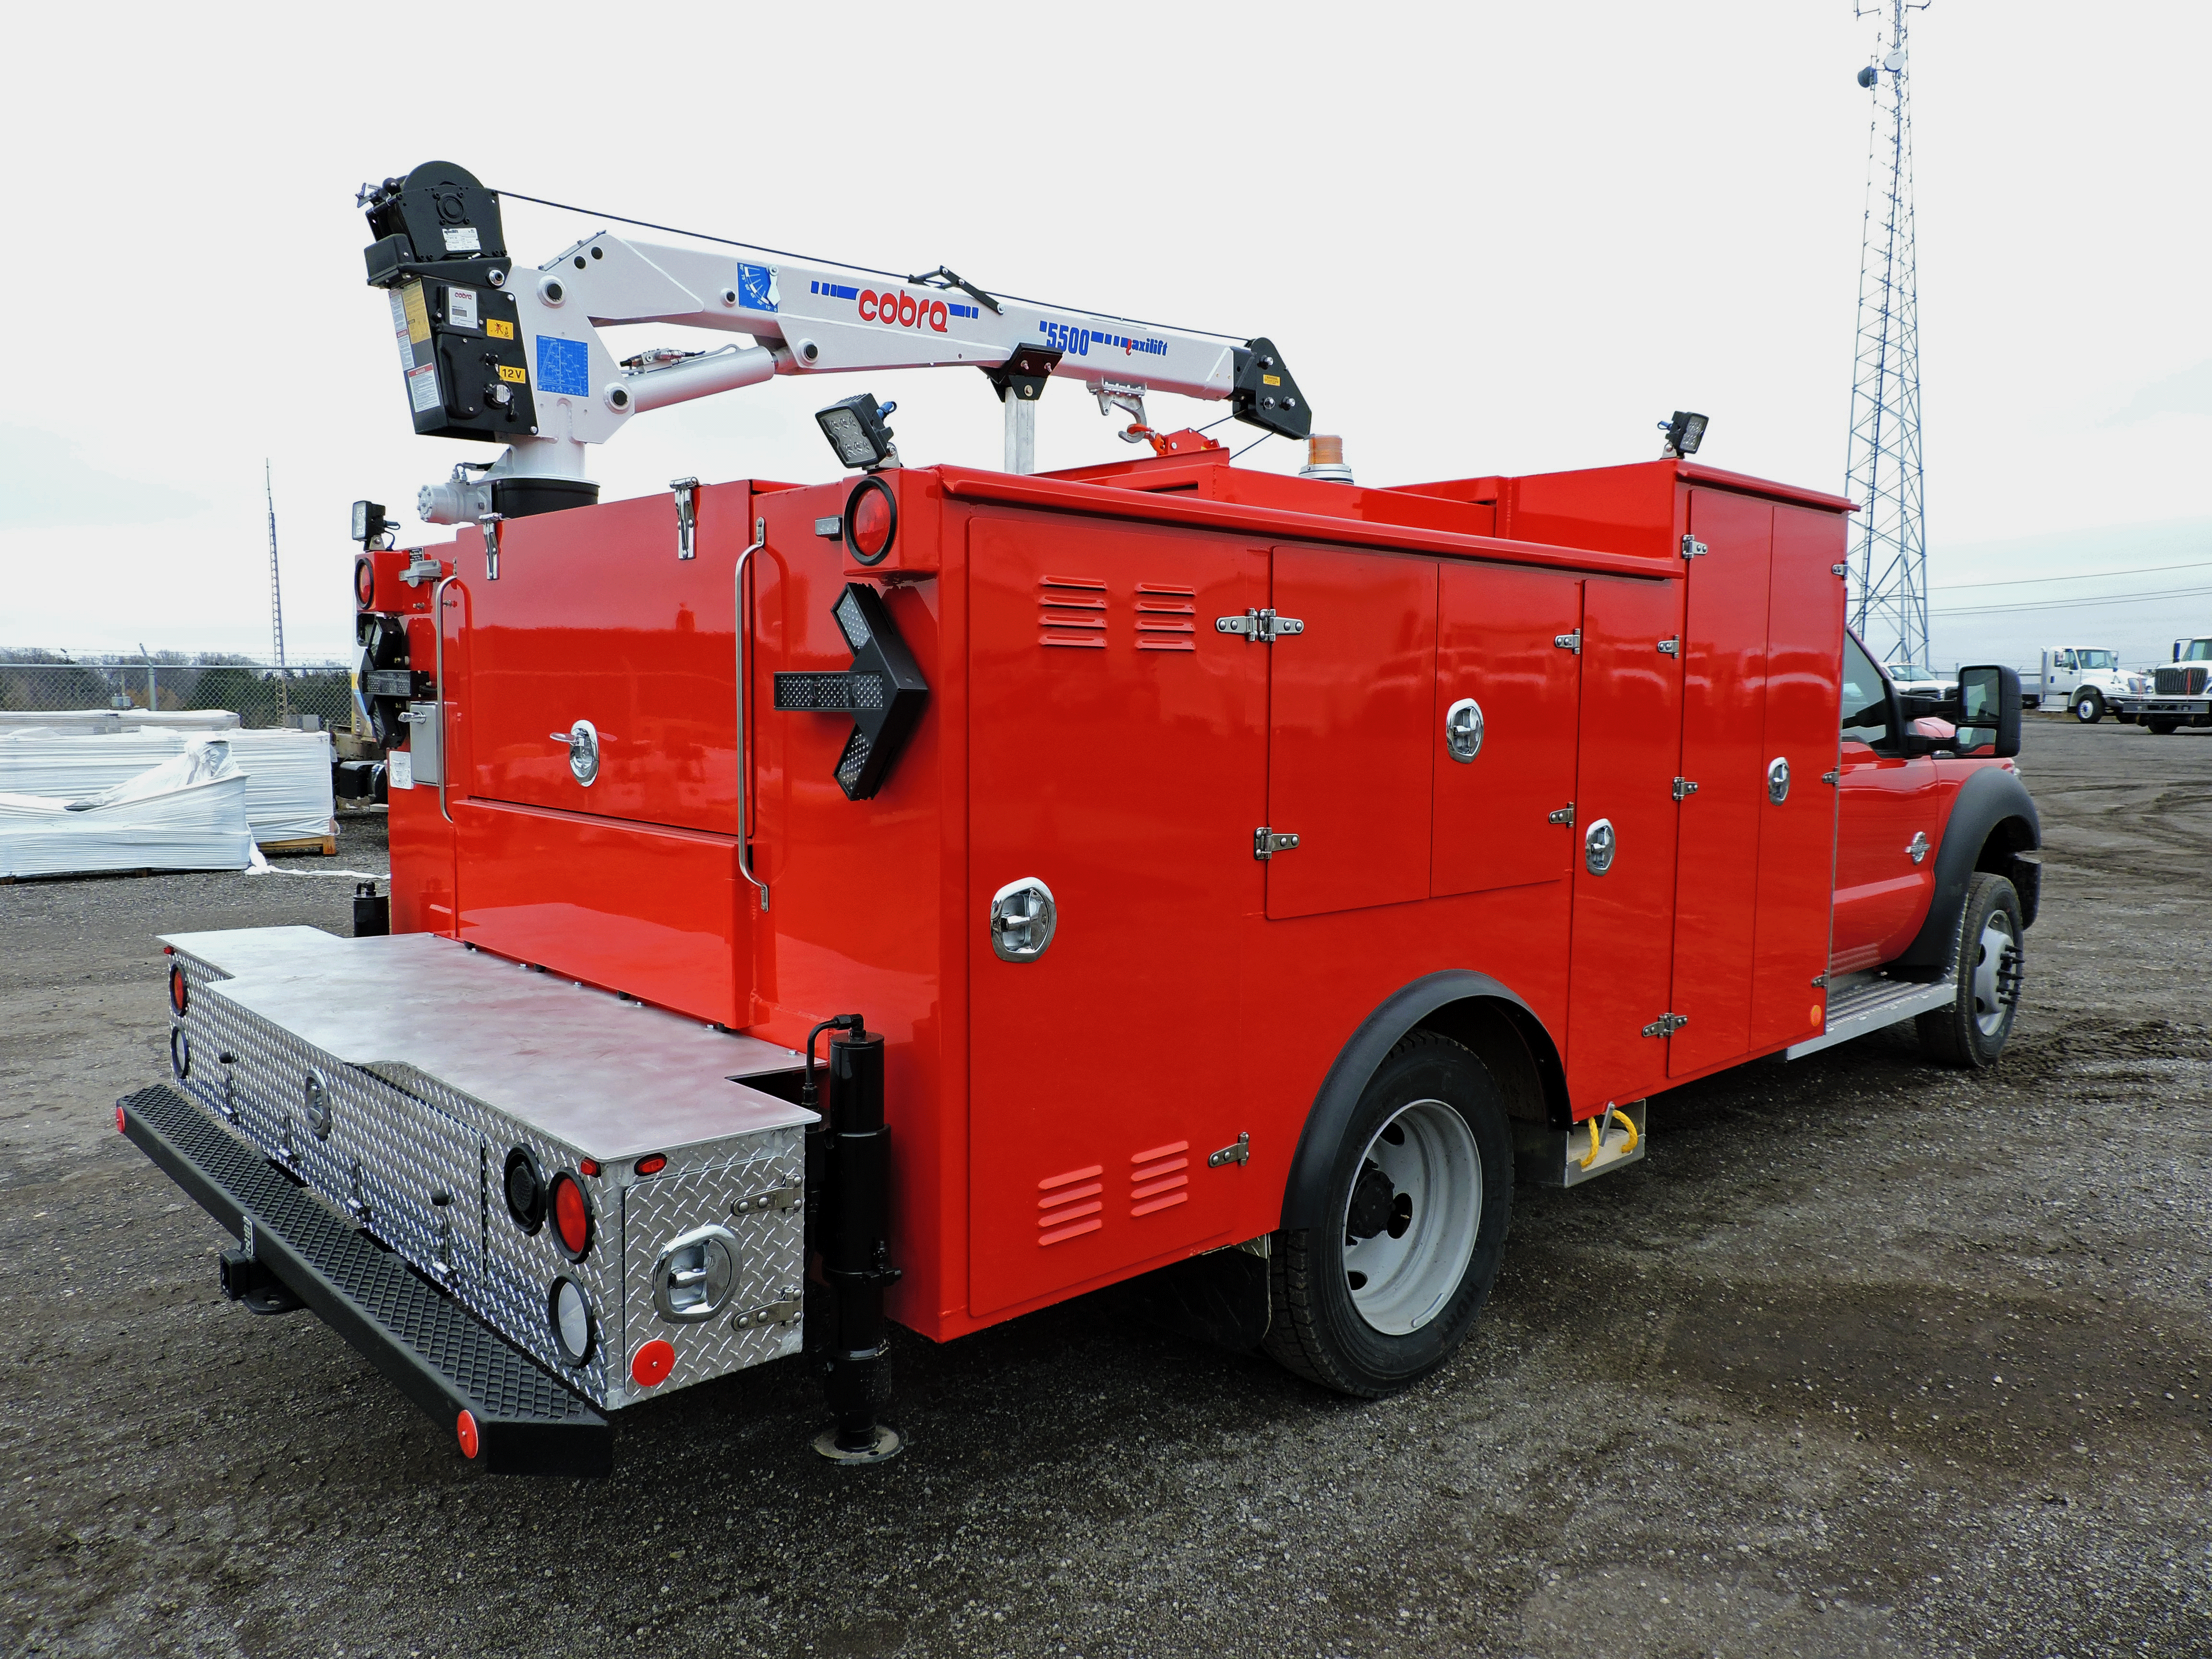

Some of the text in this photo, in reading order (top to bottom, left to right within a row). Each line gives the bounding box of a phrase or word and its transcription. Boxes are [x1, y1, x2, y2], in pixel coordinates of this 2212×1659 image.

[455, 292, 472, 300] cobra
[858, 289, 948, 333] cobra
[1046, 322, 1090, 356] 5500
[502, 369, 521, 379] 12V
